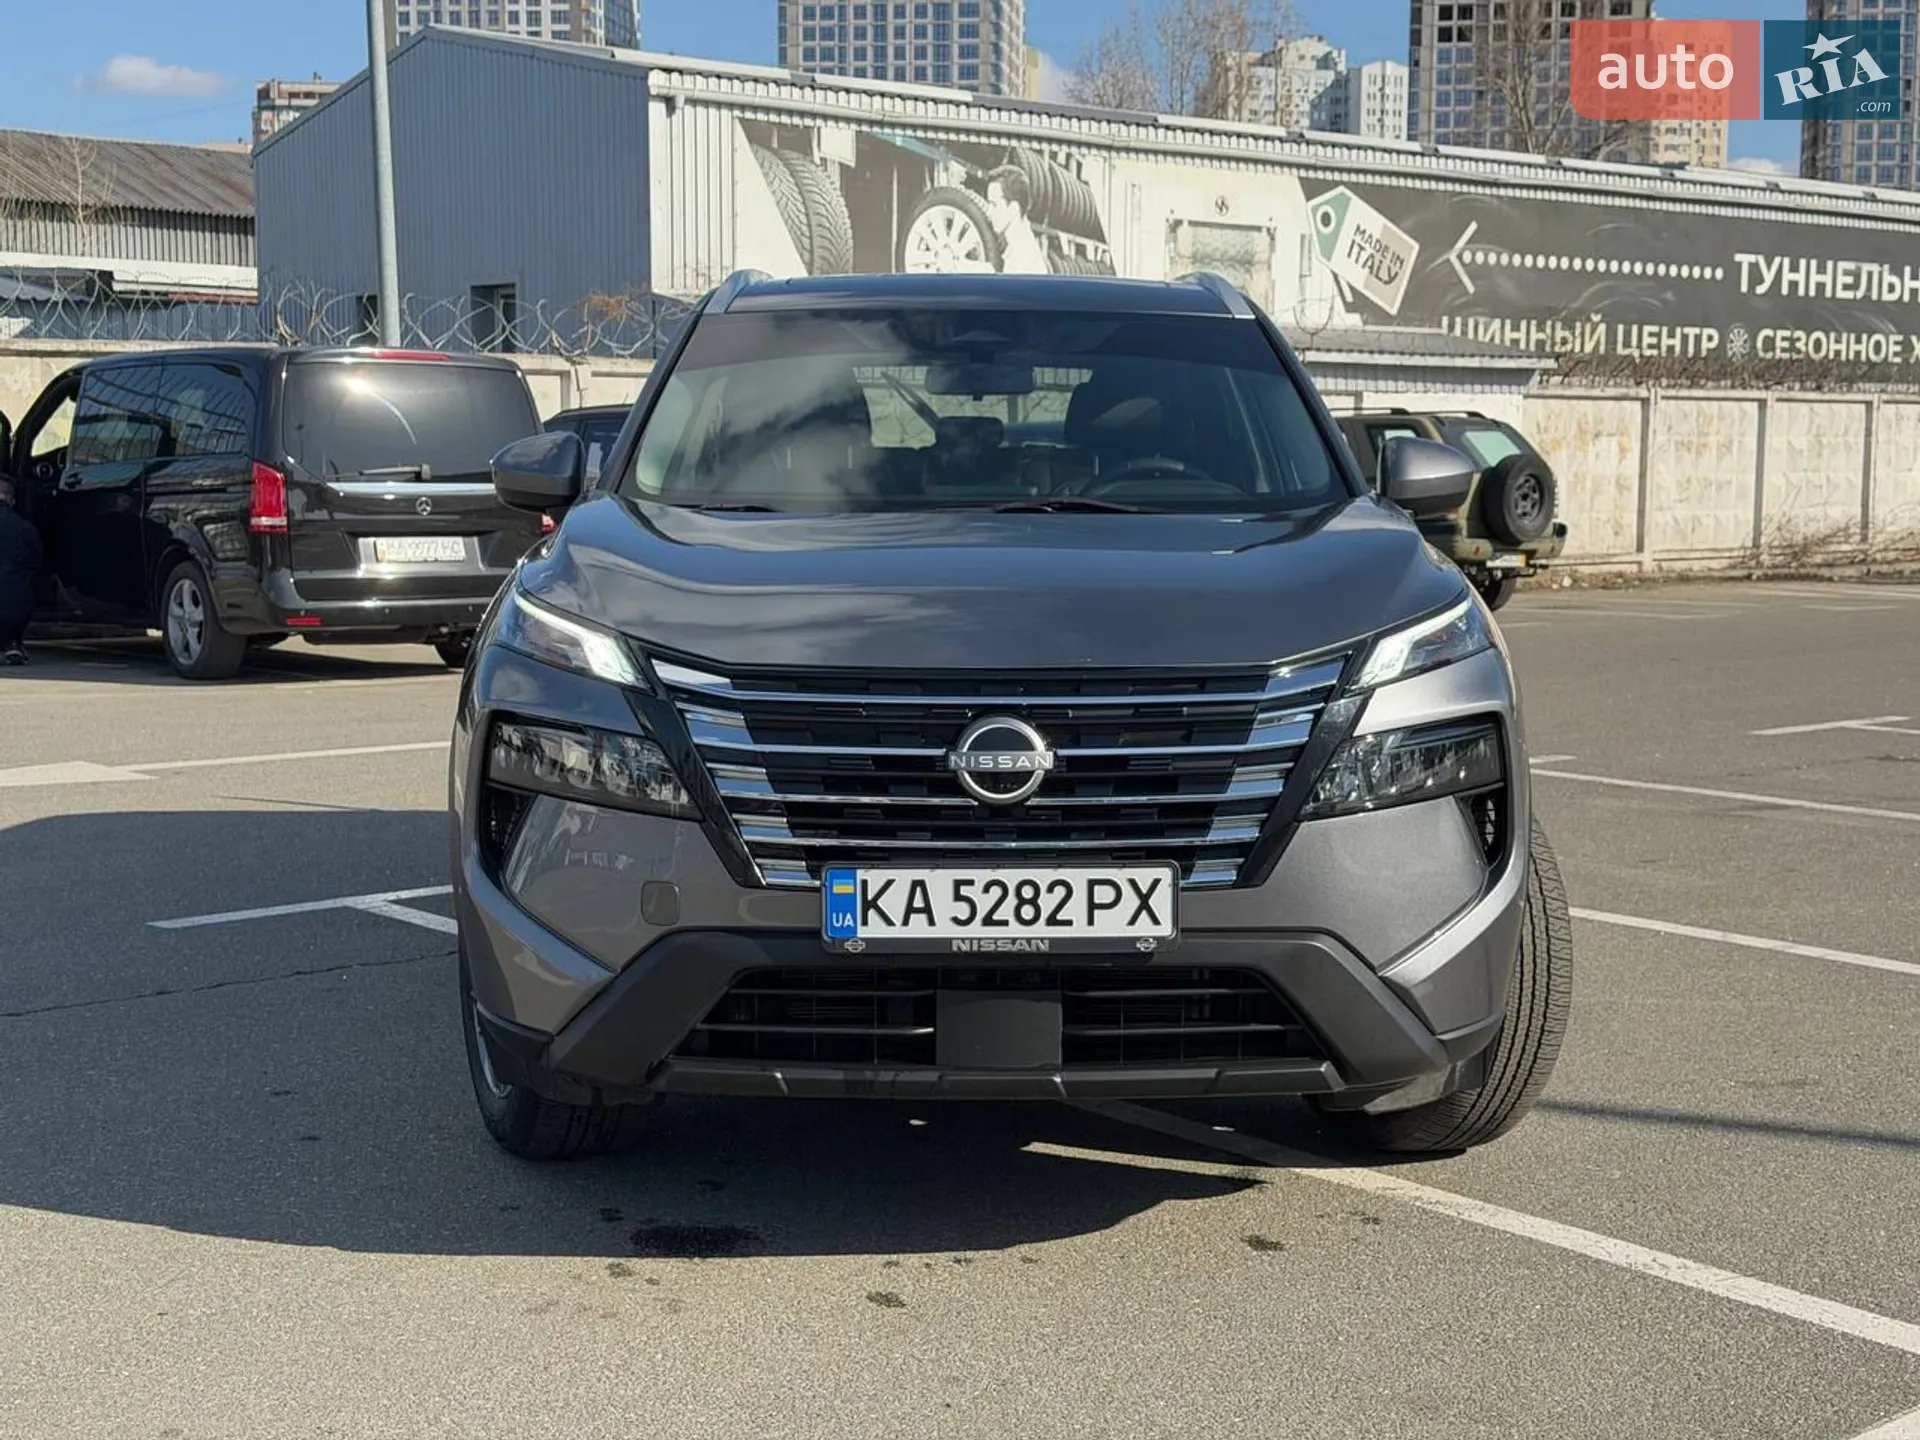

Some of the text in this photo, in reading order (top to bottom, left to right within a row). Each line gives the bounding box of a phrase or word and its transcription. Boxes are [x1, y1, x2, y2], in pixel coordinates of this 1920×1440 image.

[1347, 239, 1399, 285] ITALY
[1353, 222, 1405, 272] MADE IN
[1615, 323, 1720, 363] ЦЕНТР
[1756, 328, 1904, 363] СЕЗОННОЕ
[950, 755, 1051, 769] NISSAN
[832, 912, 855, 928] UA
[860, 878, 1162, 927] KA 5282 PX
[951, 939, 1050, 952] NISSAN
